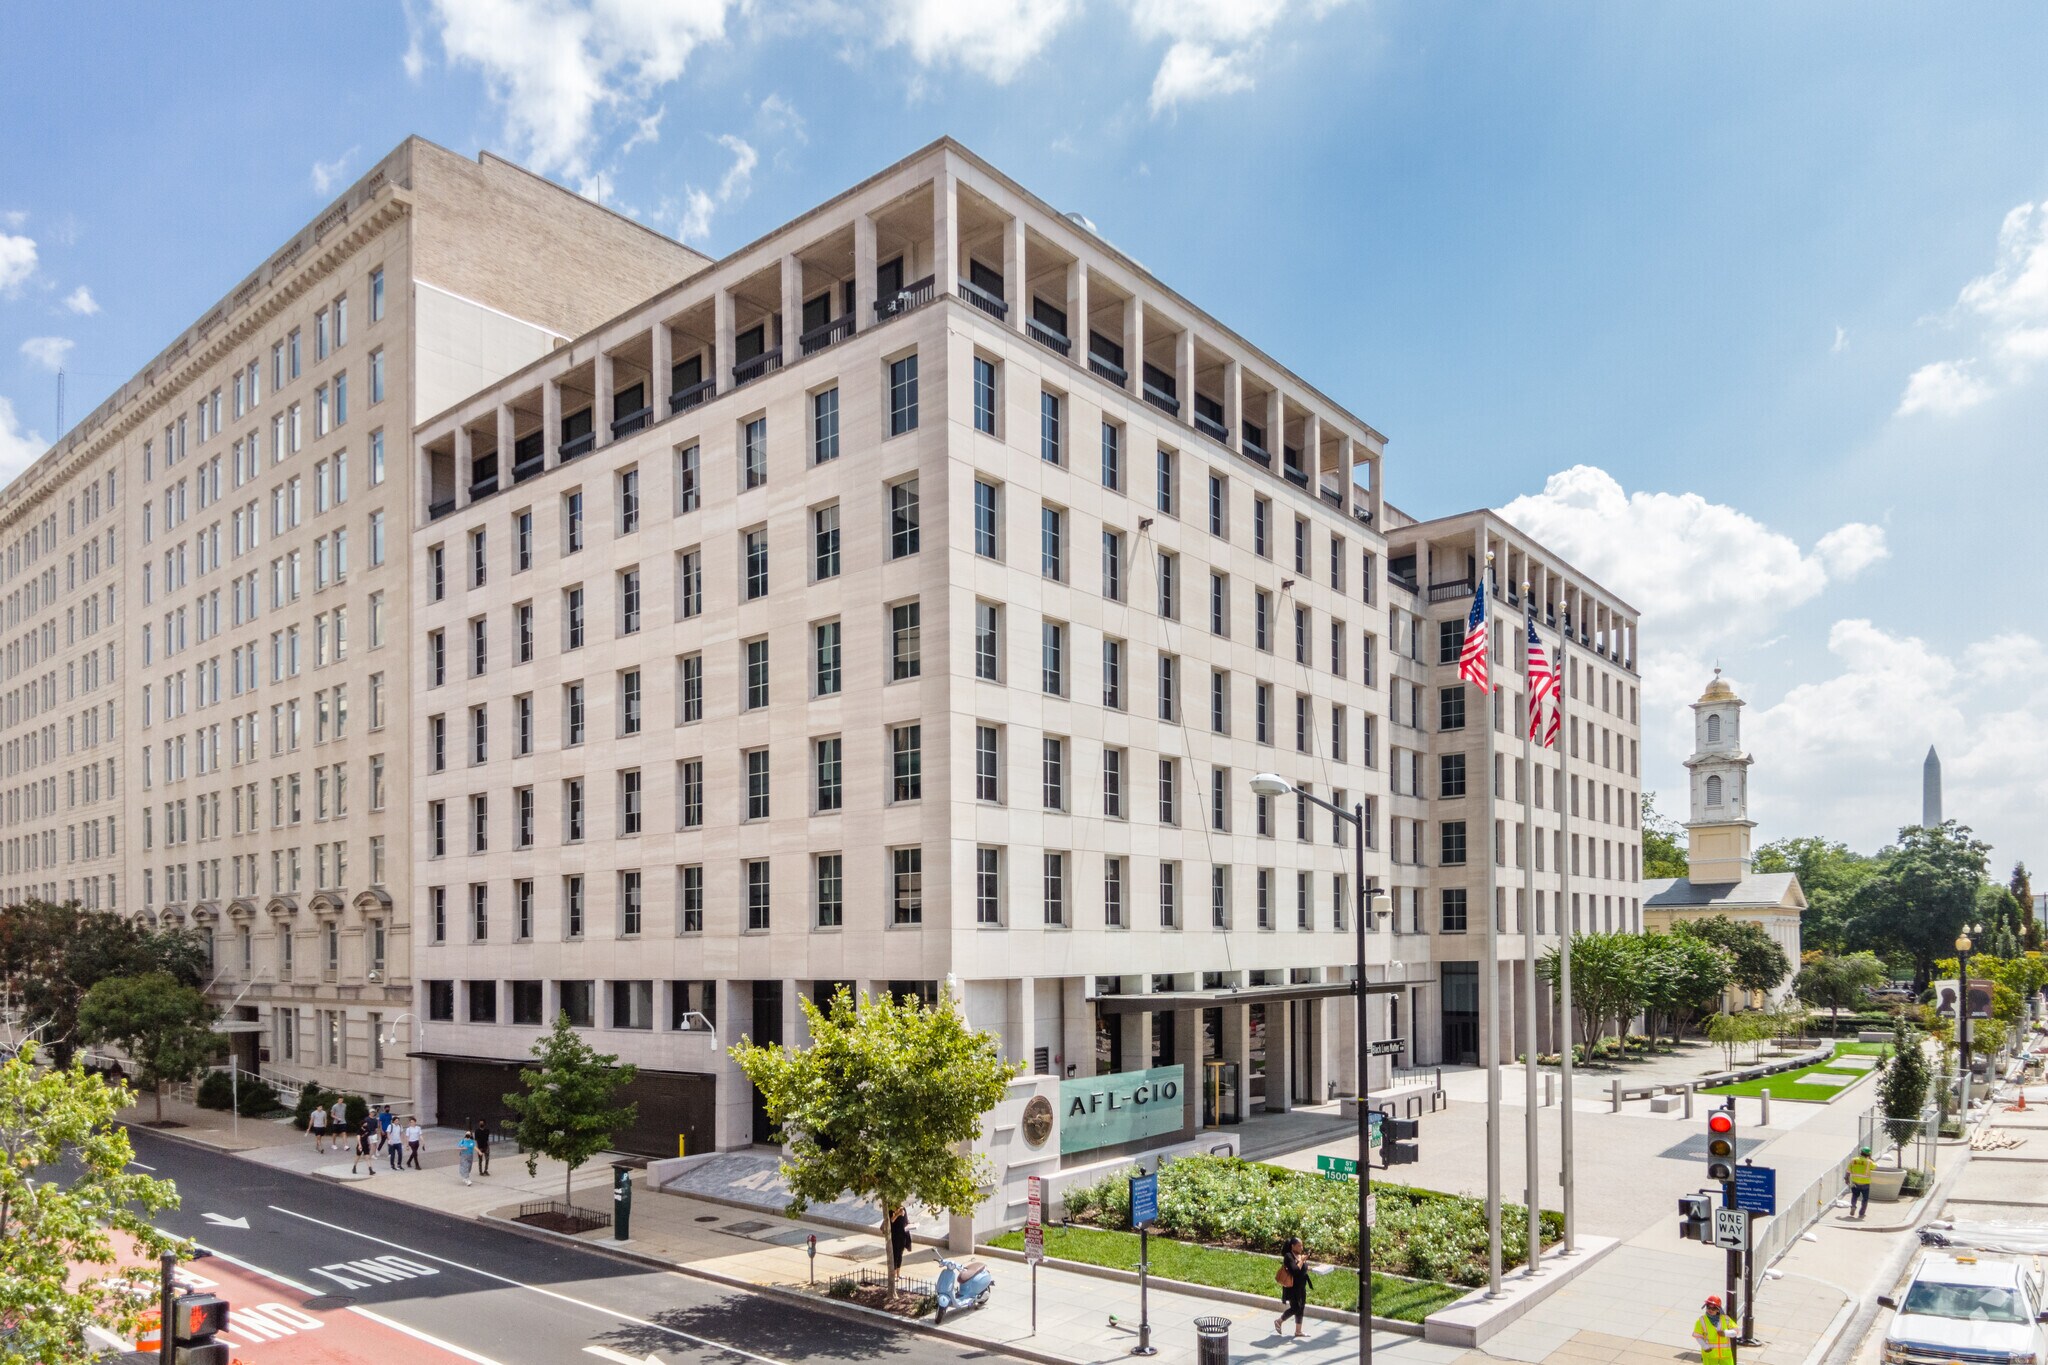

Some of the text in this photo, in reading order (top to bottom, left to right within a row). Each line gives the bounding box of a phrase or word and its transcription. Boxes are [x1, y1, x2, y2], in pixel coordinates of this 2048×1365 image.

[1069, 1081, 1177, 1117] AFL-CIO
[1328, 1157, 1336, 1170] I
[1326, 1170, 1348, 1182] 1500
[1719, 1212, 1742, 1225] ONE
[1718, 1223, 1743, 1235] WAY
[308, 1255, 440, 1290] ONLY
[207, 1302, 325, 1349] ON
